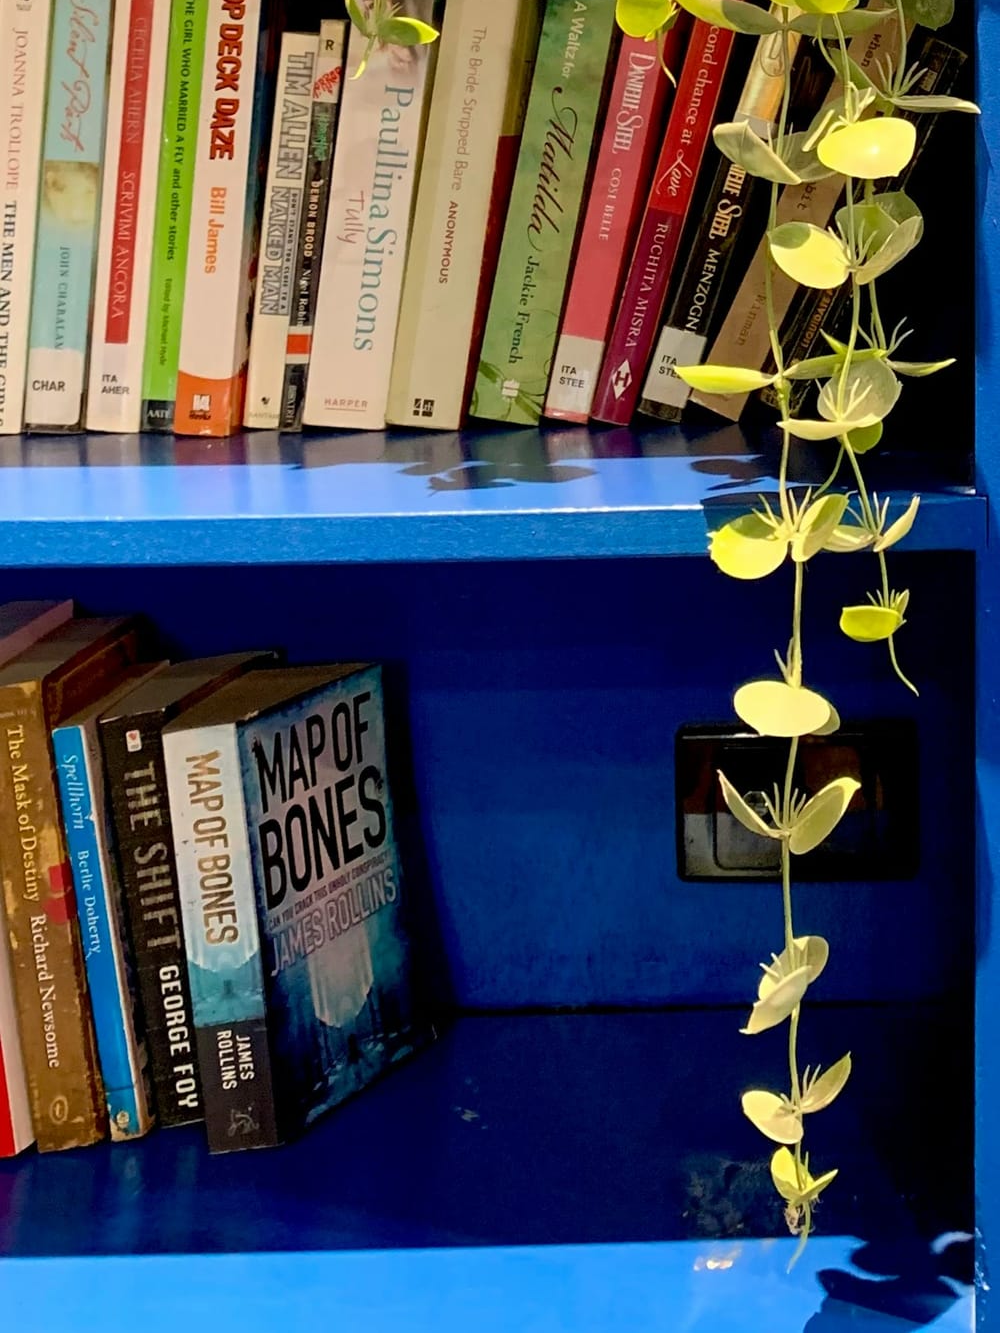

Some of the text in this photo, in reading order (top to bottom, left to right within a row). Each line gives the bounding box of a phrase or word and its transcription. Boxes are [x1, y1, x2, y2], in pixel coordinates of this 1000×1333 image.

[181, 48, 192, 78] WHO
[183, 19, 194, 47] GIRL
[214, 23, 245, 93] DECK
[324, 38, 335, 51] R
[861, 33, 882, 68] when
[176, 80, 190, 132] MARRIED
[209, 97, 240, 161] DAZE
[451, 25, 488, 191] The Bride Stripped Bare
[528, 0, 588, 252] A Waltz for Matilda
[110, 17, 146, 319] CECELIA AHERN SCRIVIMI ANCORA
[174, 146, 185, 165] FLY
[175, 135, 184, 144] A
[169, 191, 181, 222] other
[171, 168, 181, 189] and
[259, 51, 315, 316] TIM ALLEN NAKED MAN
[166, 224, 178, 261] stories
[204, 186, 228, 275] Bill James
[353, 84, 414, 352] Paullina Simons
[438, 200, 459, 285] ANONYMOUS
[508, 255, 541, 364] Jackie French
[624, 222, 669, 348] RUCHITA MISRA
[32, 379, 66, 392] CHAR
[101, 374, 118, 384] ITA
[101, 385, 130, 395] AHER
[558, 376, 585, 388] STEE
[561, 365, 577, 375] ITA
[661, 354, 678, 366] ITA
[324, 397, 368, 409] HARPER
[252, 691, 371, 815] MAP OF
[7, 723, 40, 904] The Mask of Destiny
[258, 764, 387, 912] BONES
[63, 754, 102, 956] Spellhorn Berlie Doherty
[124, 761, 182, 951] THE SHIFT
[185, 749, 240, 946] MAP OF BONES
[270, 867, 397, 977] JAMES ROLLINS
[30, 913, 60, 1068] Richard Newsome
[159, 964, 199, 1110] GEORGE FOY
[216, 1029, 238, 1091] ROLLINS
[236, 1034, 255, 1082] JAMES
